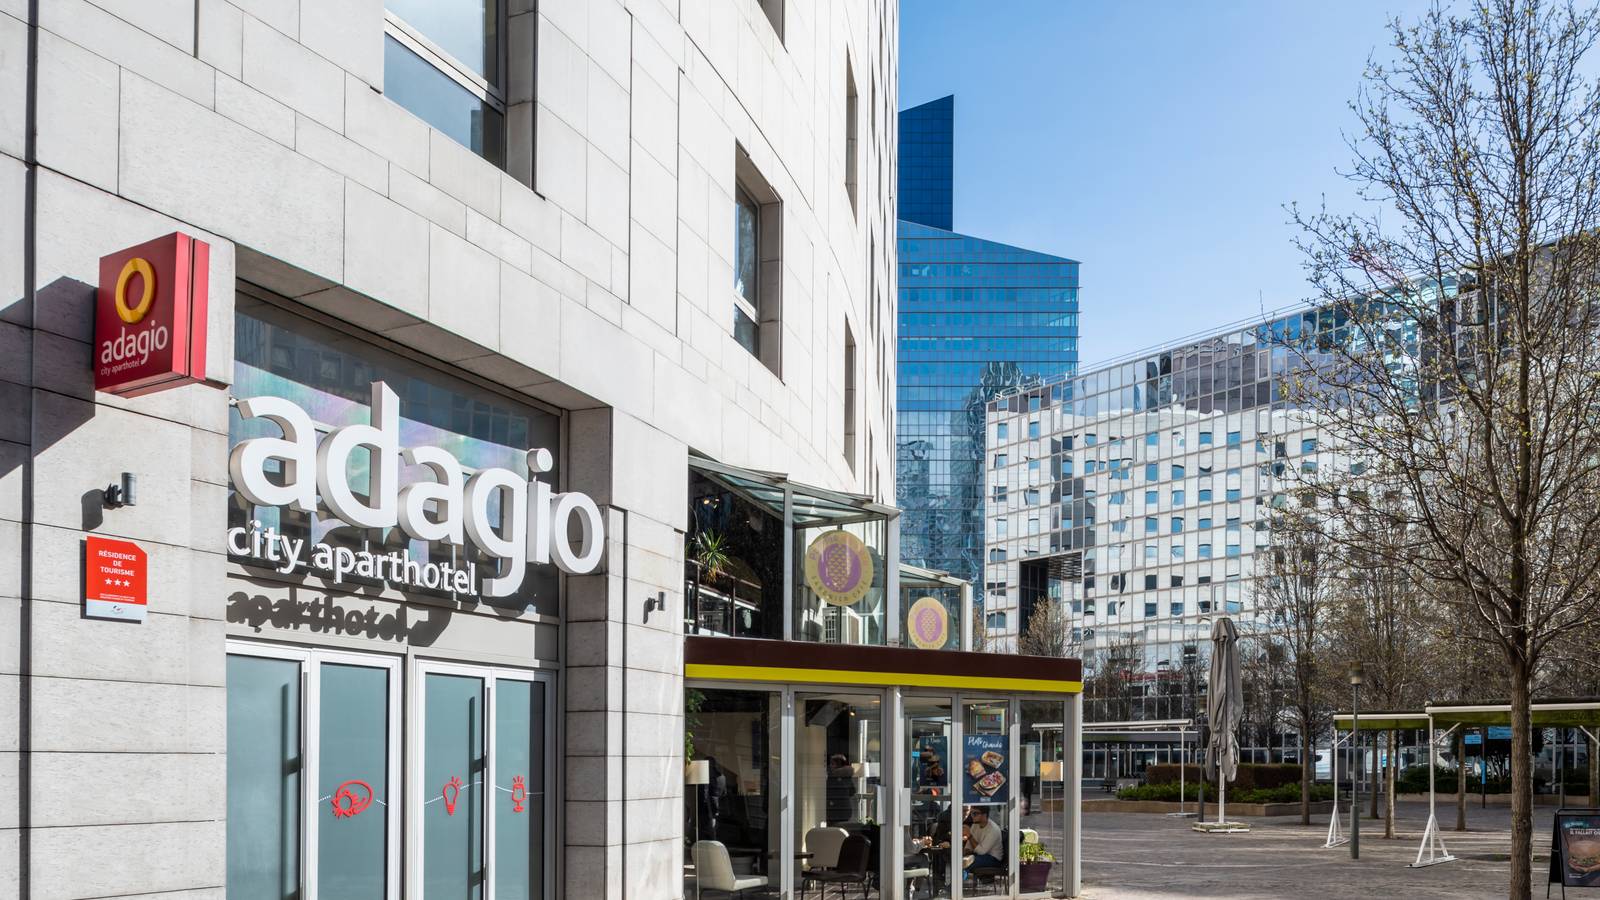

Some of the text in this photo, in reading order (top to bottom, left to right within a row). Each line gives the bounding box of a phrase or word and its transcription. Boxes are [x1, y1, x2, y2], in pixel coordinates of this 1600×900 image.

[101, 320, 168, 365] adagio
[101, 358, 140, 377] city aparthotel
[229, 381, 604, 597] adagio
[100, 566, 135, 577] TOURISME
[227, 519, 478, 596] city aparthotel
